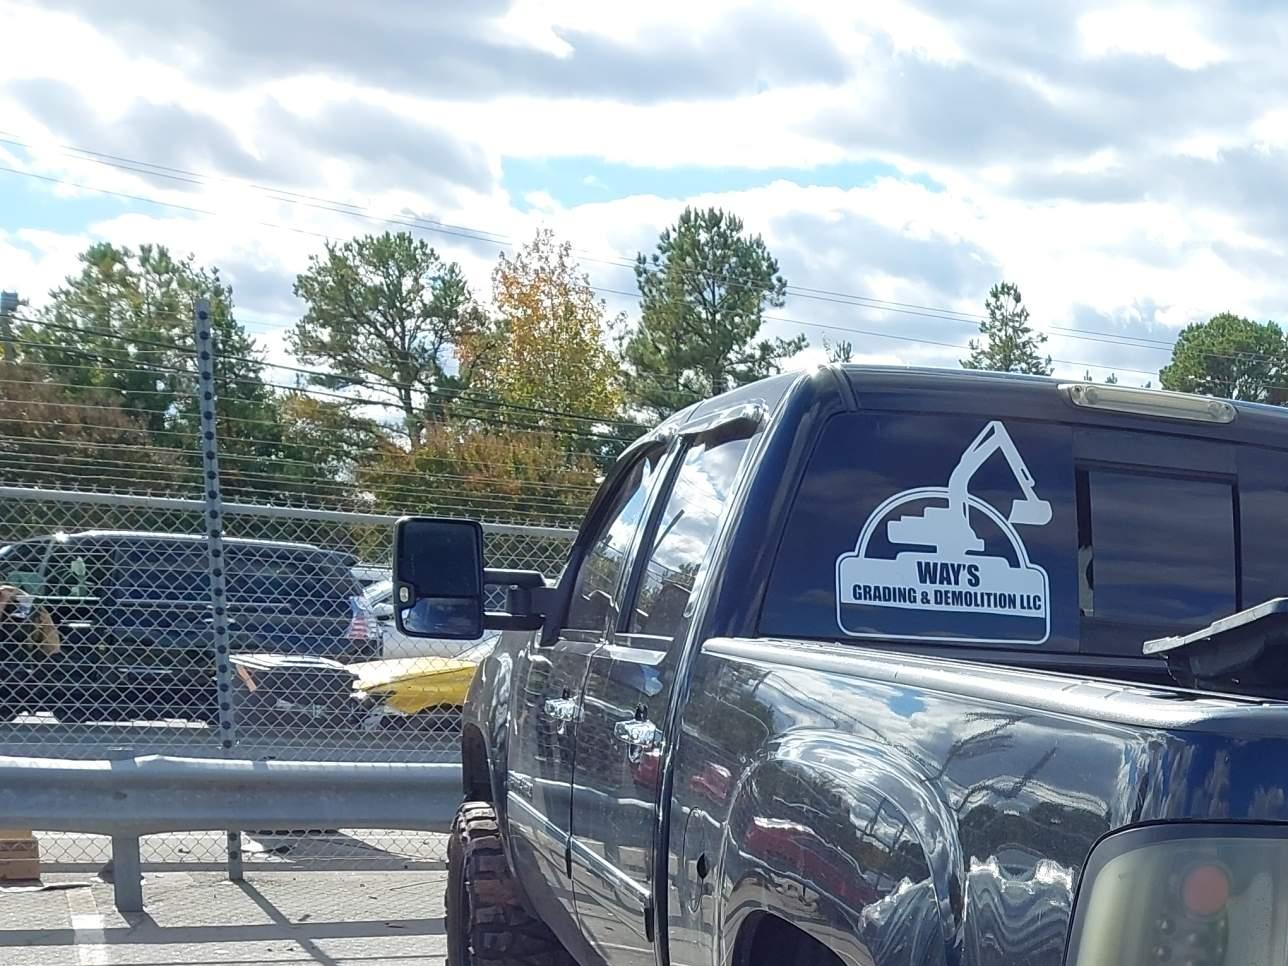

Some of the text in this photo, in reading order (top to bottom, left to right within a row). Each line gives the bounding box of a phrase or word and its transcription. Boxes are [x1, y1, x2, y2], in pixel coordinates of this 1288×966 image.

[916, 560, 981, 588] WAY'S
[852, 583, 1042, 611] GRADING & DEMOLITION LLC
